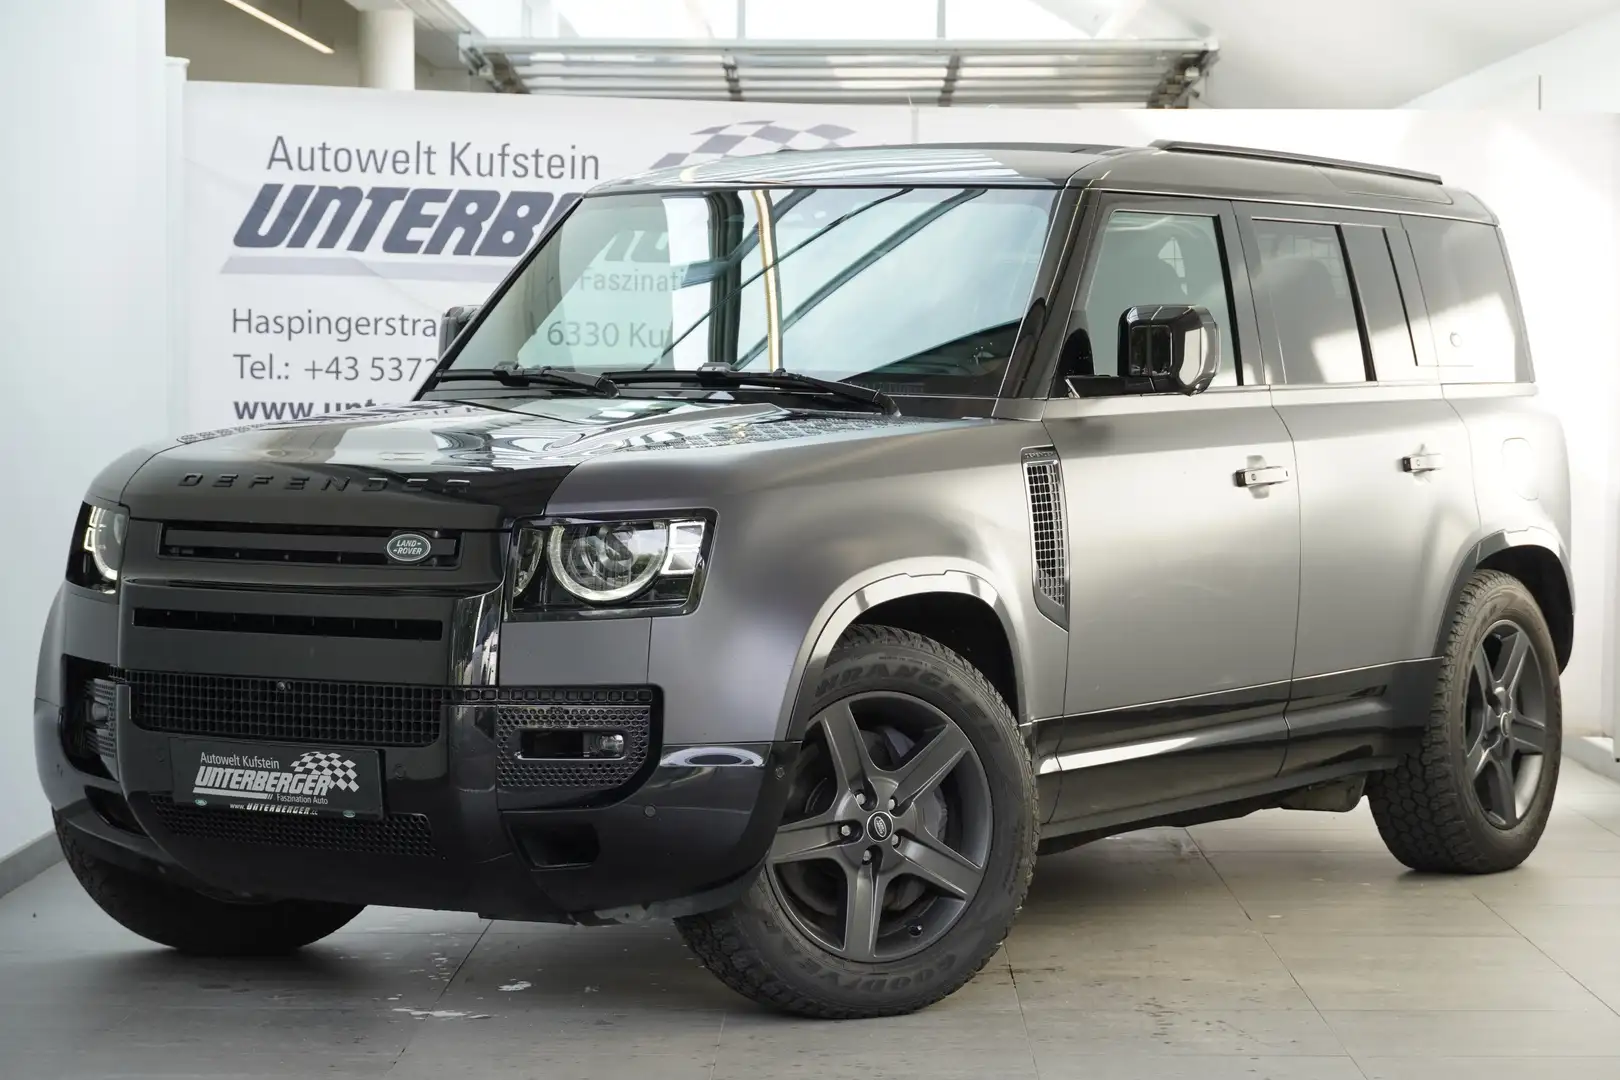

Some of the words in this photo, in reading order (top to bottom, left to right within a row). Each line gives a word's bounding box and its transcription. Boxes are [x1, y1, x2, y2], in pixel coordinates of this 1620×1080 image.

[267, 135, 437, 176] Autowelt
[450, 141, 599, 180] Kufstein
[547, 320, 620, 348] 6330
[233, 353, 290, 380] Tel.:
[304, 356, 360, 381] +43
[178, 473, 471, 493] DEFENDER
[200, 751, 241, 767] Autowelt
[242, 755, 280, 769] Kufstein
[194, 765, 332, 796] UNTERBERGER
[276, 793, 312, 804] Faszination
[312, 796, 329, 805] Auto
